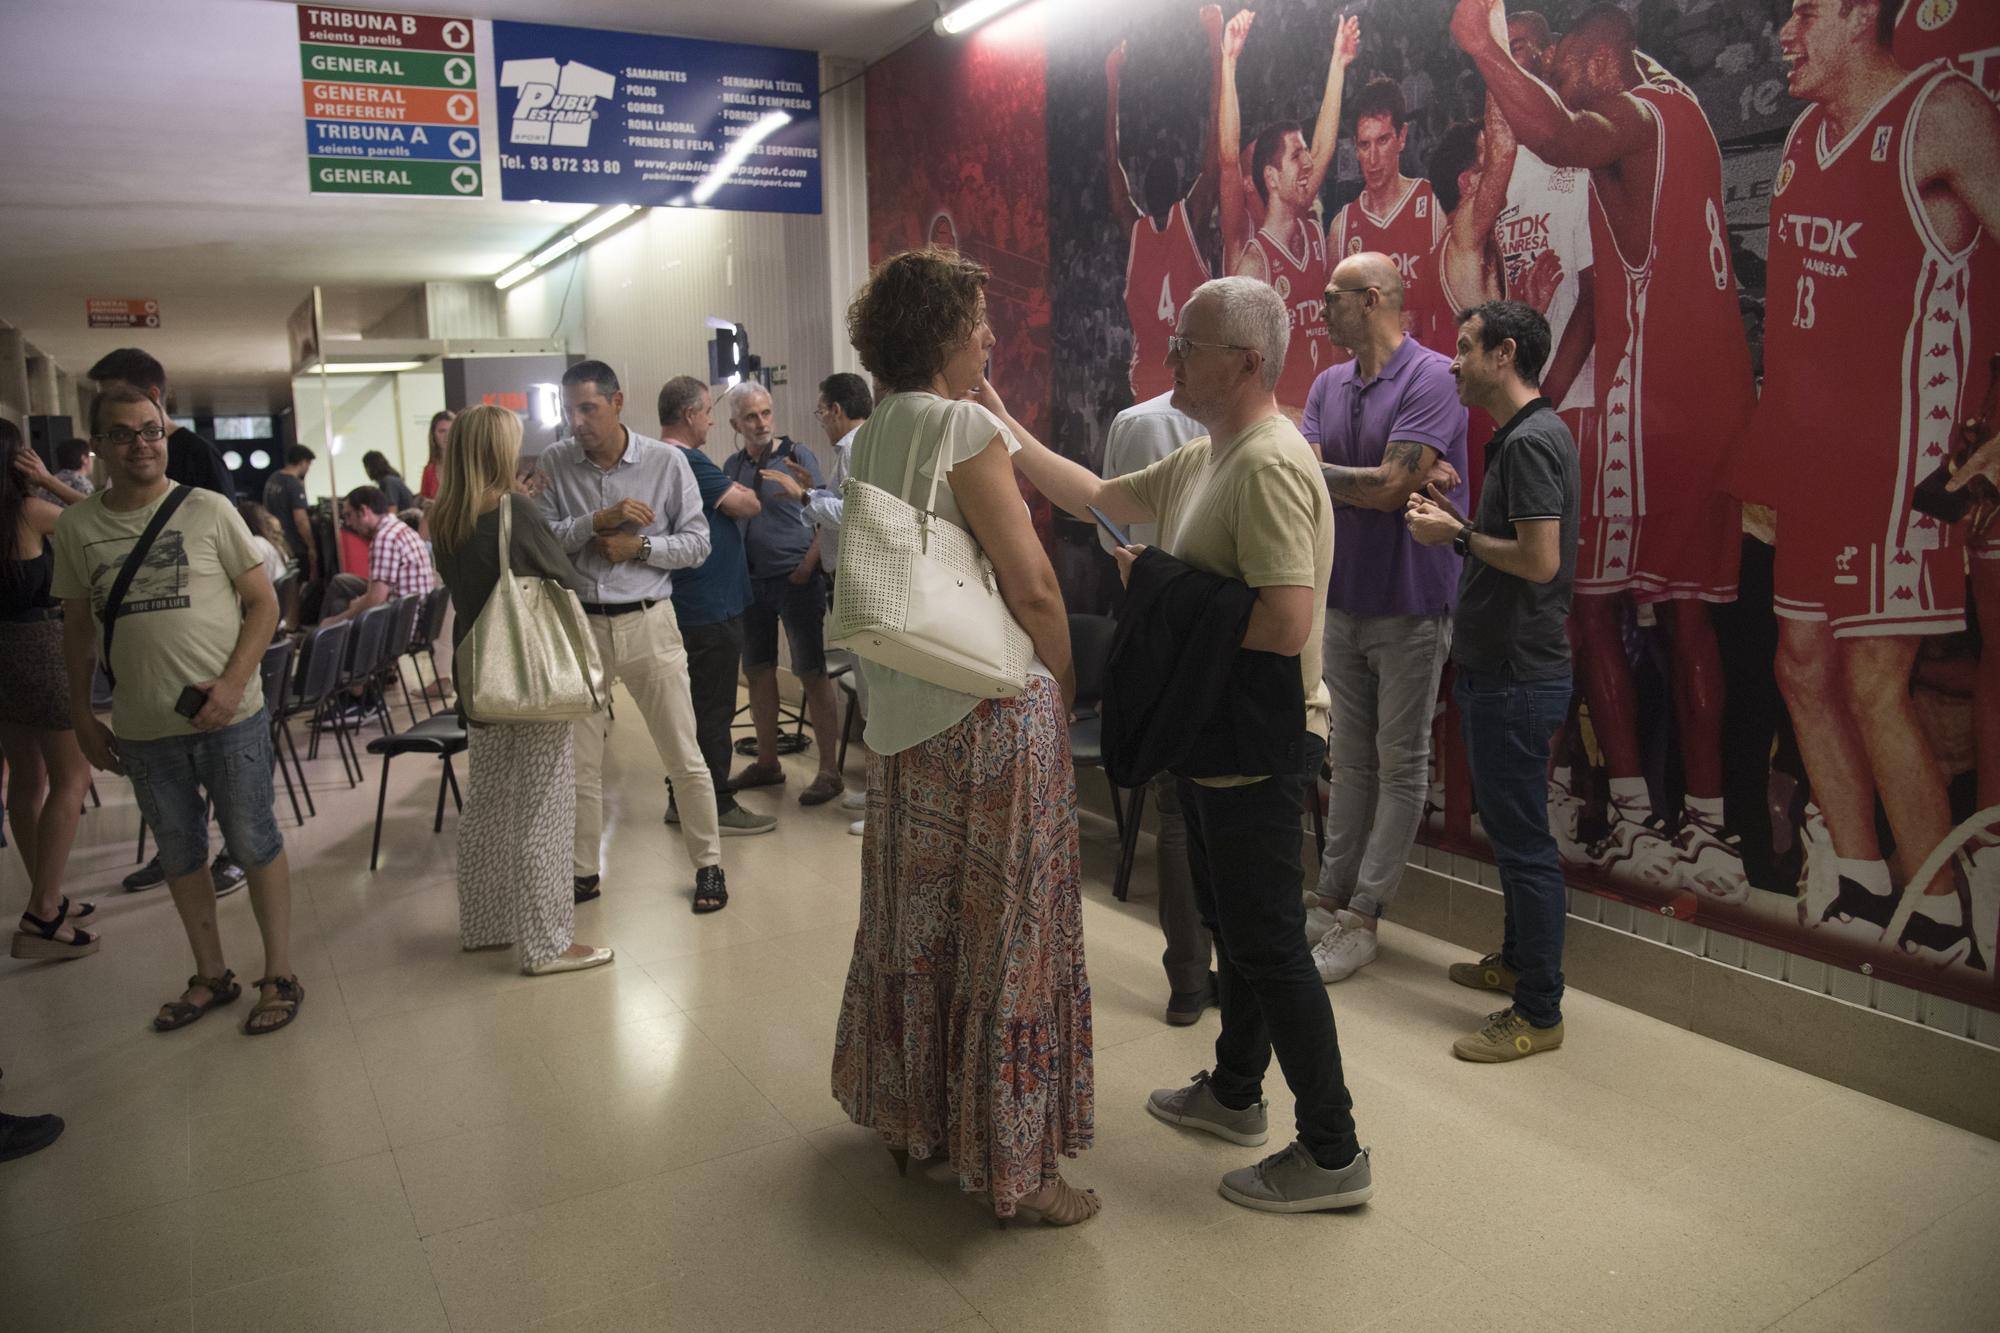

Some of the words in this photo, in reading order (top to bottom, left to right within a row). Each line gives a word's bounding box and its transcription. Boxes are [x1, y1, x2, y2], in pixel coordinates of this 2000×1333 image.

[308, 10, 397, 31] TRIBUNA
[402, 16, 417, 35] B
[309, 30, 354, 42] seients
[359, 33, 402, 46] parells
[311, 55, 404, 76] GENERAL
[625, 67, 688, 82] SAMARRETES
[722, 76, 774, 90] SERIGRAFIA
[313, 85, 406, 104] GENERAL
[626, 84, 657, 98] POLOS
[627, 102, 664, 114] GORRES
[723, 93, 756, 106] REGALS
[758, 96, 812, 110] D'EMPRESAS
[314, 103, 406, 120] PREFERENT
[528, 109, 590, 124] ESTAMP
[724, 110, 758, 122] FORROS
[316, 124, 405, 141] TRIBUNA
[410, 127, 428, 144] A
[628, 119, 654, 130] ROBA
[655, 121, 696, 134] LABORAL
[318, 144, 364, 155] seients
[368, 146, 410, 158] parells
[628, 136, 671, 148] PRENDES
[672, 138, 685, 150] DE
[687, 139, 714, 152] FELPA
[766, 145, 818, 158] ESPORTIVES
[500, 154, 526, 170] Tel.
[530, 156, 548, 170] 93
[552, 157, 578, 172] 872
[582, 159, 600, 173] 33
[604, 160, 620, 174] 80
[320, 168, 412, 186] GENERAL
[1504, 213, 1551, 241] TDK
[1500, 235, 1550, 254] ANRESA
[1706, 198, 1728, 290] 8
[1788, 214, 1863, 258] TDK
[1158, 272, 1176, 326] 4
[1792, 275, 1815, 328] 13
